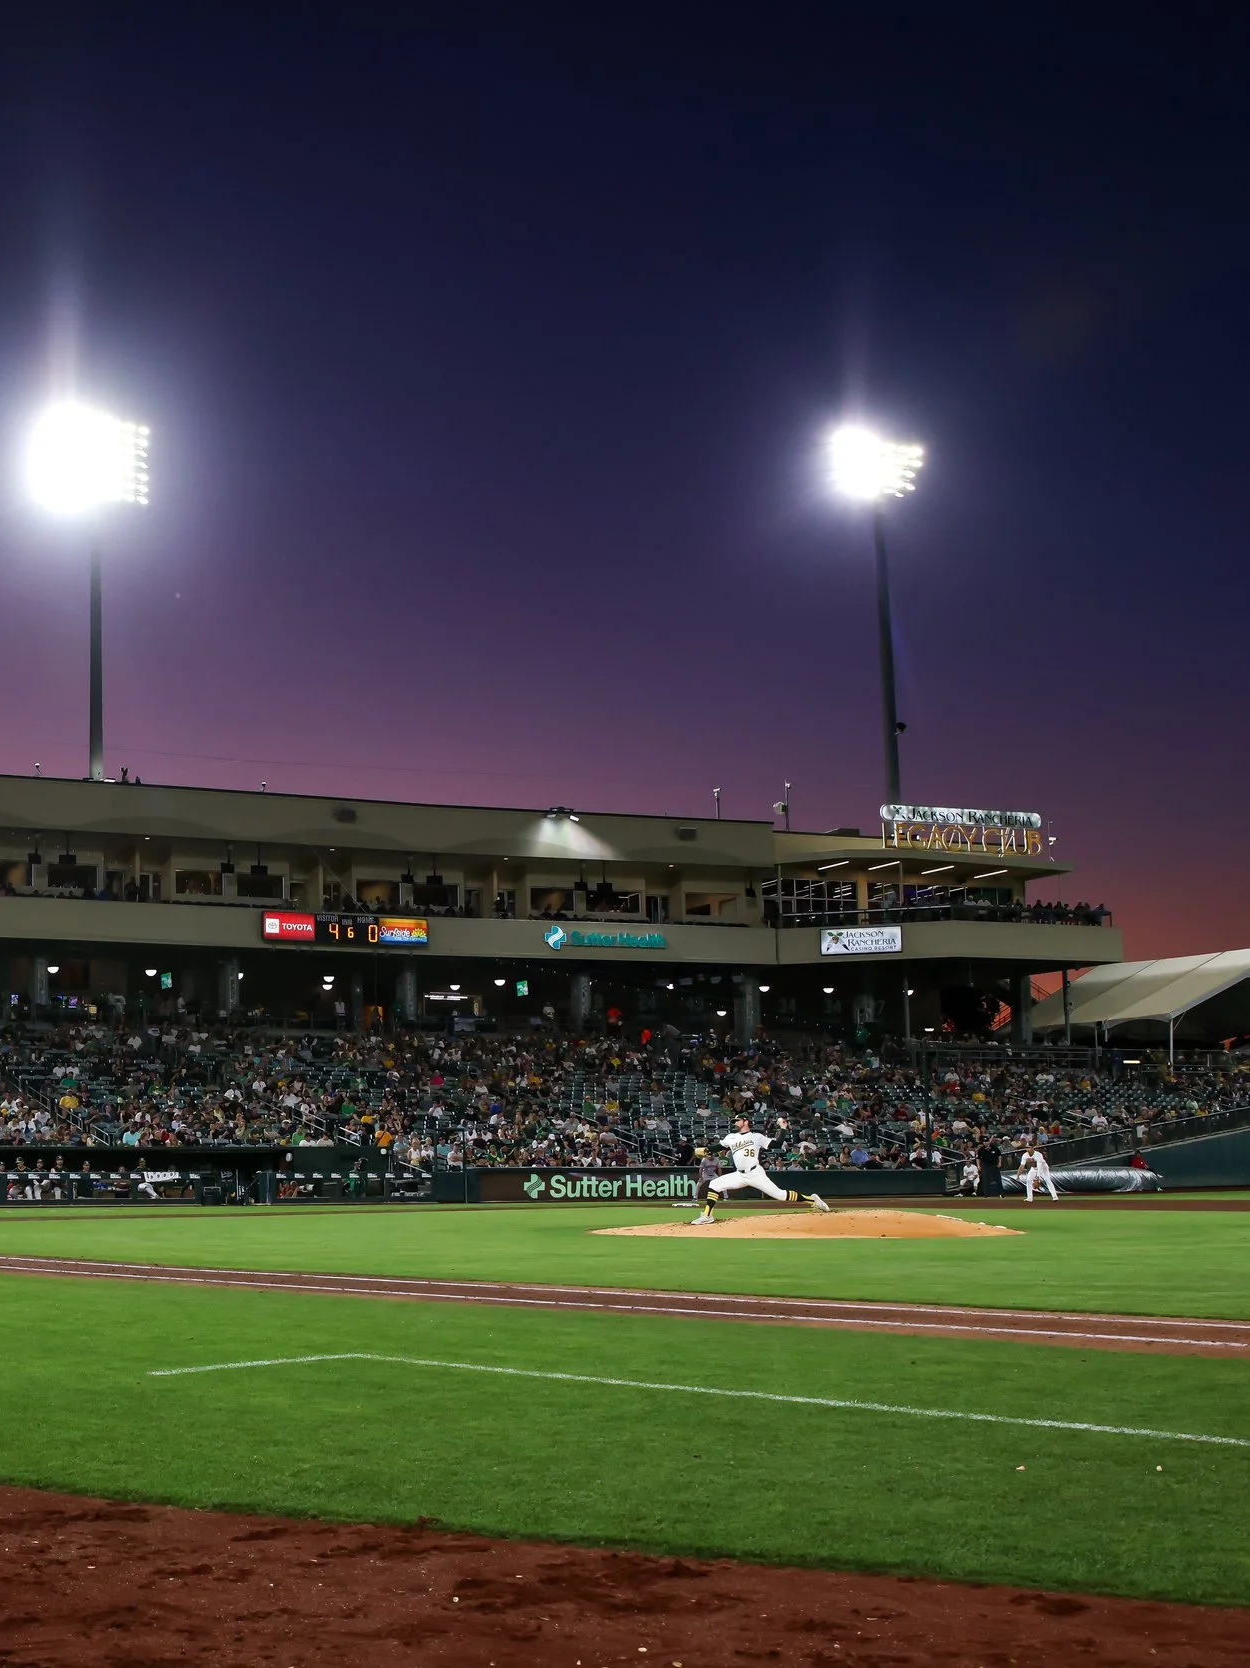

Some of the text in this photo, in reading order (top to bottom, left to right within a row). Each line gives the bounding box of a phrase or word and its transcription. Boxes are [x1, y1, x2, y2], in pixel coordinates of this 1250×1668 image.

[907, 807, 1033, 827] JACKSON RANCHERIA
[881, 822, 1044, 856] LEGACY CLUB
[316, 914, 339, 922] VISITOR
[282, 922, 313, 932] TOYOTA
[328, 923, 378, 943] 4 6 0
[379, 926, 411, 938] Surfside
[571, 930, 667, 949] Sutter Health
[843, 930, 884, 939] JACKSON
[848, 938, 897, 947] RANCHERIA
[743, 1148, 755, 1158] 36
[549, 1174, 697, 1198] Sutter Health
